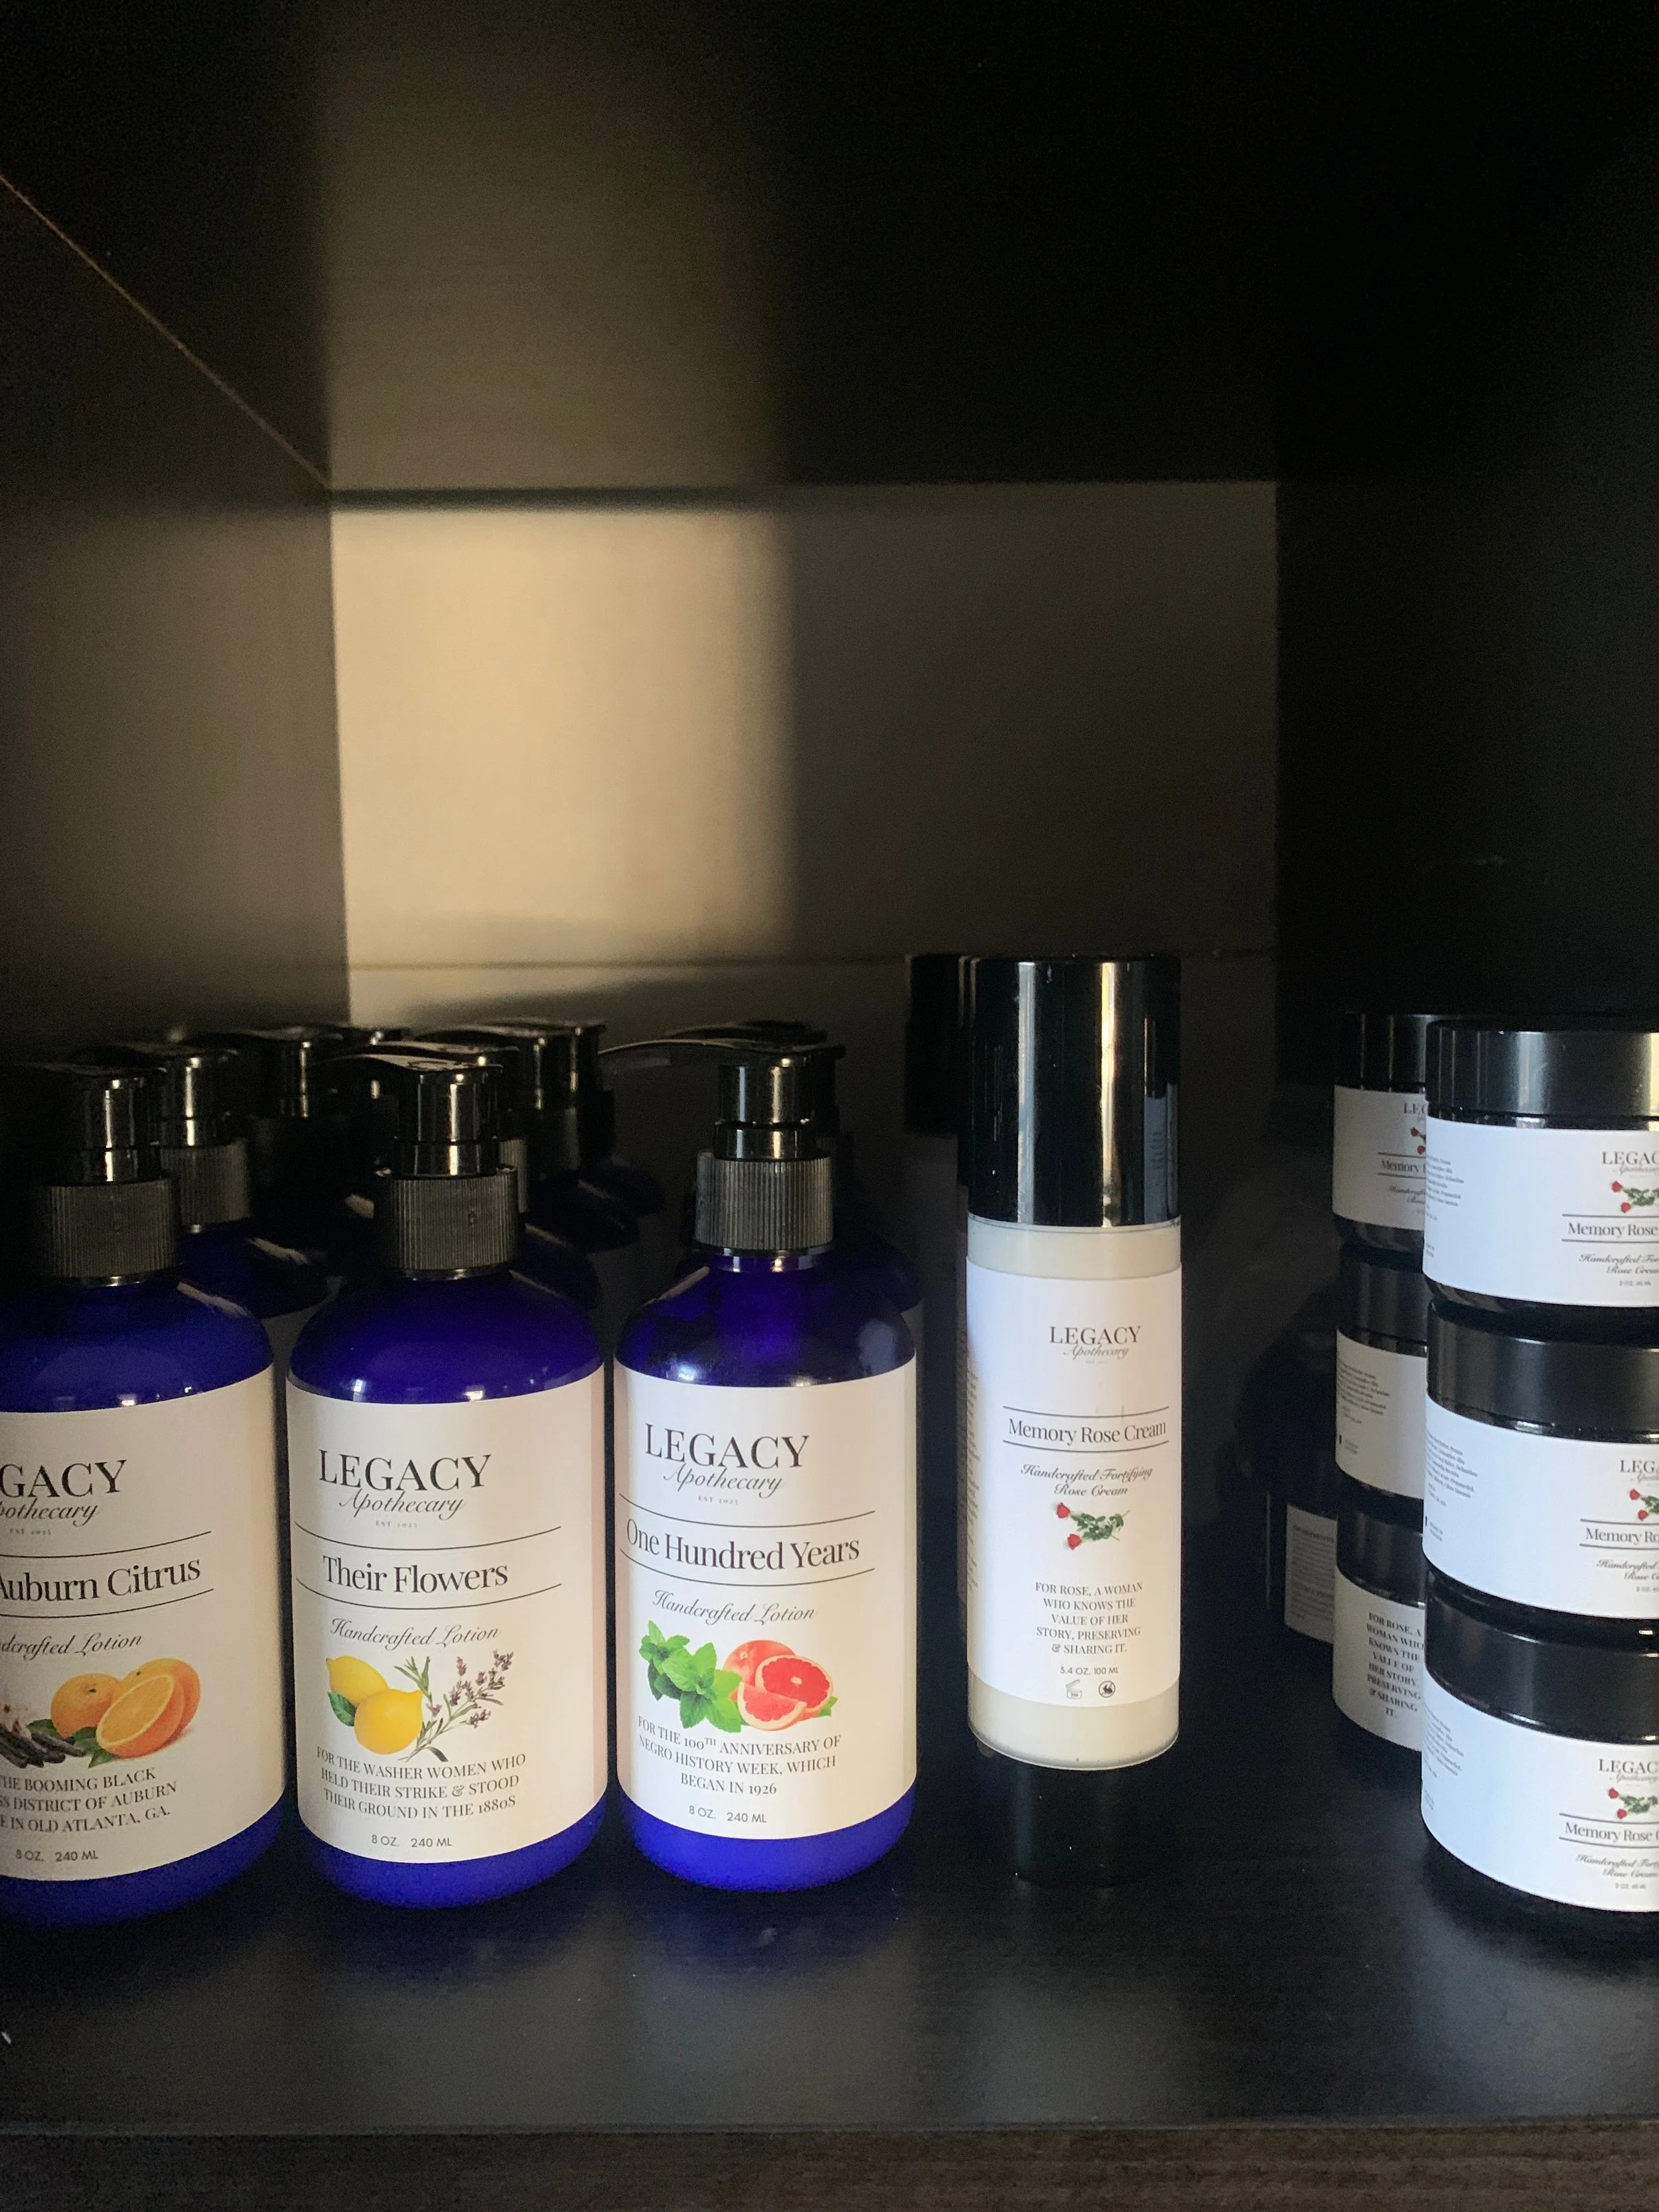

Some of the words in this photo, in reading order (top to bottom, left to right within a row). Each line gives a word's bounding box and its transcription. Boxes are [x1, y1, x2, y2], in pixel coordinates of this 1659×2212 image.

[1602, 1151, 1659, 1165] LEGAC
[1568, 1222, 1625, 1238] Memory
[1628, 1223, 1658, 1236] Rose
[1049, 1325, 1141, 1345] LEGACY
[1063, 1343, 1129, 1361] Apothecary
[1008, 1418, 1077, 1445] Memory
[1080, 1426, 1120, 1444] Rose
[1124, 1421, 1167, 1441] Cream
[645, 1422, 810, 1470] LEGACY
[319, 1448, 492, 1492] LEGACY
[1021, 1463, 1099, 1485] Handcrafted
[1099, 1466, 1153, 1484] Fortifying
[1620, 1459, 1659, 1473] LEG
[0, 1459, 127, 1499] GACY
[662, 1463, 784, 1499] Apothecary
[1054, 1483, 1087, 1497] Rose
[1091, 1484, 1129, 1497] Cream
[0, 1497, 99, 1527] othecary
[338, 1488, 465, 1521] Apothecary
[626, 1518, 660, 1556] One
[664, 1532, 786, 1571] Hundred
[790, 1538, 861, 1568] Years
[1586, 1527, 1642, 1545] Memory
[1644, 1530, 1659, 1544] Ro
[108, 1560, 200, 1596] Citrus
[323, 1555, 388, 1592] Their
[394, 1564, 509, 1593] Flowers
[1035, 1582, 1056, 1593] FOR
[1060, 1585, 1092, 1597] ROSE,
[1094, 1586, 1102, 1595] A
[1104, 1582, 1143, 1595] WOMAN
[652, 1589, 757, 1626] Handcrafted
[754, 1602, 816, 1626] Lotion
[1043, 1597, 1070, 1610] WHO
[1073, 1600, 1114, 1611] KNOWS
[1115, 1598, 1136, 1609] THE
[1051, 1614, 1087, 1625] VALUE
[1090, 1616, 1105, 1625] OF
[1107, 1614, 1129, 1624] HER
[1369, 1612, 1384, 1626] FOR
[0, 1634, 76, 1660] dcrafted
[74, 1631, 142, 1657] Lotion
[330, 1617, 437, 1651] Handcrafted
[435, 1624, 500, 1648] Lotion
[1036, 1627, 1075, 1641] STORY,
[1078, 1627, 1141, 1641] PRESERVING
[1367, 1623, 1398, 1643] WOMAN
[1400, 1637, 1424, 1651] WHO
[1051, 1643, 1061, 1653] &
[1063, 1644, 1113, 1655] SHARING
[1114, 1644, 1127, 1653] IT.
[1368, 1637, 1399, 1656] KNOWS
[1402, 1650, 1420, 1661] THE
[1075, 1666, 1092, 1675] OZ.
[1094, 1666, 1106, 1675] 100
[1368, 1661, 1385, 1676] HER
[1401, 1662, 1414, 1672] OF
[1367, 1673, 1421, 1700] PRESERVING
[1377, 1692, 1417, 1712] SHARING
[638, 1714, 656, 1735] FOR
[658, 1726, 681, 1745] THE
[719, 1738, 820, 1756] ANNIVERSARY
[823, 1734, 842, 1750] OF
[317, 1745, 335, 1764] FOR
[337, 1755, 360, 1773] THE
[364, 1763, 423, 1780] WASHER
[427, 1761, 488, 1780] WOMEN
[491, 1753, 527, 1772] WHO
[638, 1734, 673, 1761] NEGRO
[675, 1752, 733, 1774] HISTORY
[736, 1761, 783, 1776] WEEK,
[786, 1754, 837, 1774] WHICH
[1599, 1758, 1658, 1775] LEGAC
[0, 1775, 21, 1791] HE
[25, 1778, 98, 1792] BOOMING
[103, 1767, 157, 1789] BLACK
[321, 1767, 348, 1789] HELD
[351, 1780, 391, 1799] THEIR
[395, 1786, 448, 1800] STRIKE
[451, 1785, 466, 1798] &
[469, 1774, 520, 1795] STOOD
[680, 1772, 725, 1793] BEGAN
[729, 1781, 744, 1794] IN
[749, 1781, 778, 1797] 1926
[14, 1797, 81, 1812] DISTRICT
[85, 1796, 107, 1810] OF
[111, 1781, 177, 1808] AUBURN
[324, 1788, 356, 1811] THEIR
[358, 1801, 419, 1820] GROUND
[422, 1806, 438, 1819] IN
[442, 1803, 475, 1818] THE
[478, 1795, 517, 1814] 1880S
[11, 1816, 24, 1830] IN
[28, 1819, 58, 1832] OLD
[145, 1806, 170, 1820] GA.
[689, 1805, 695, 1815] 8
[697, 1806, 717, 1820] OZ.
[727, 1812, 749, 1823] 240
[751, 1812, 767, 1824] ML
[371, 1834, 378, 1844] 8
[380, 1836, 399, 1847] OZ.
[410, 1836, 433, 1848] 240
[436, 1836, 453, 1848] ML
[1565, 1822, 1622, 1843] Memory
[1624, 1829, 1650, 1842] Rose
[15, 1849, 22, 1860] 8
[25, 1850, 44, 1862] OZ.
[55, 1851, 78, 1862] 240
[81, 1850, 99, 1861] ML
